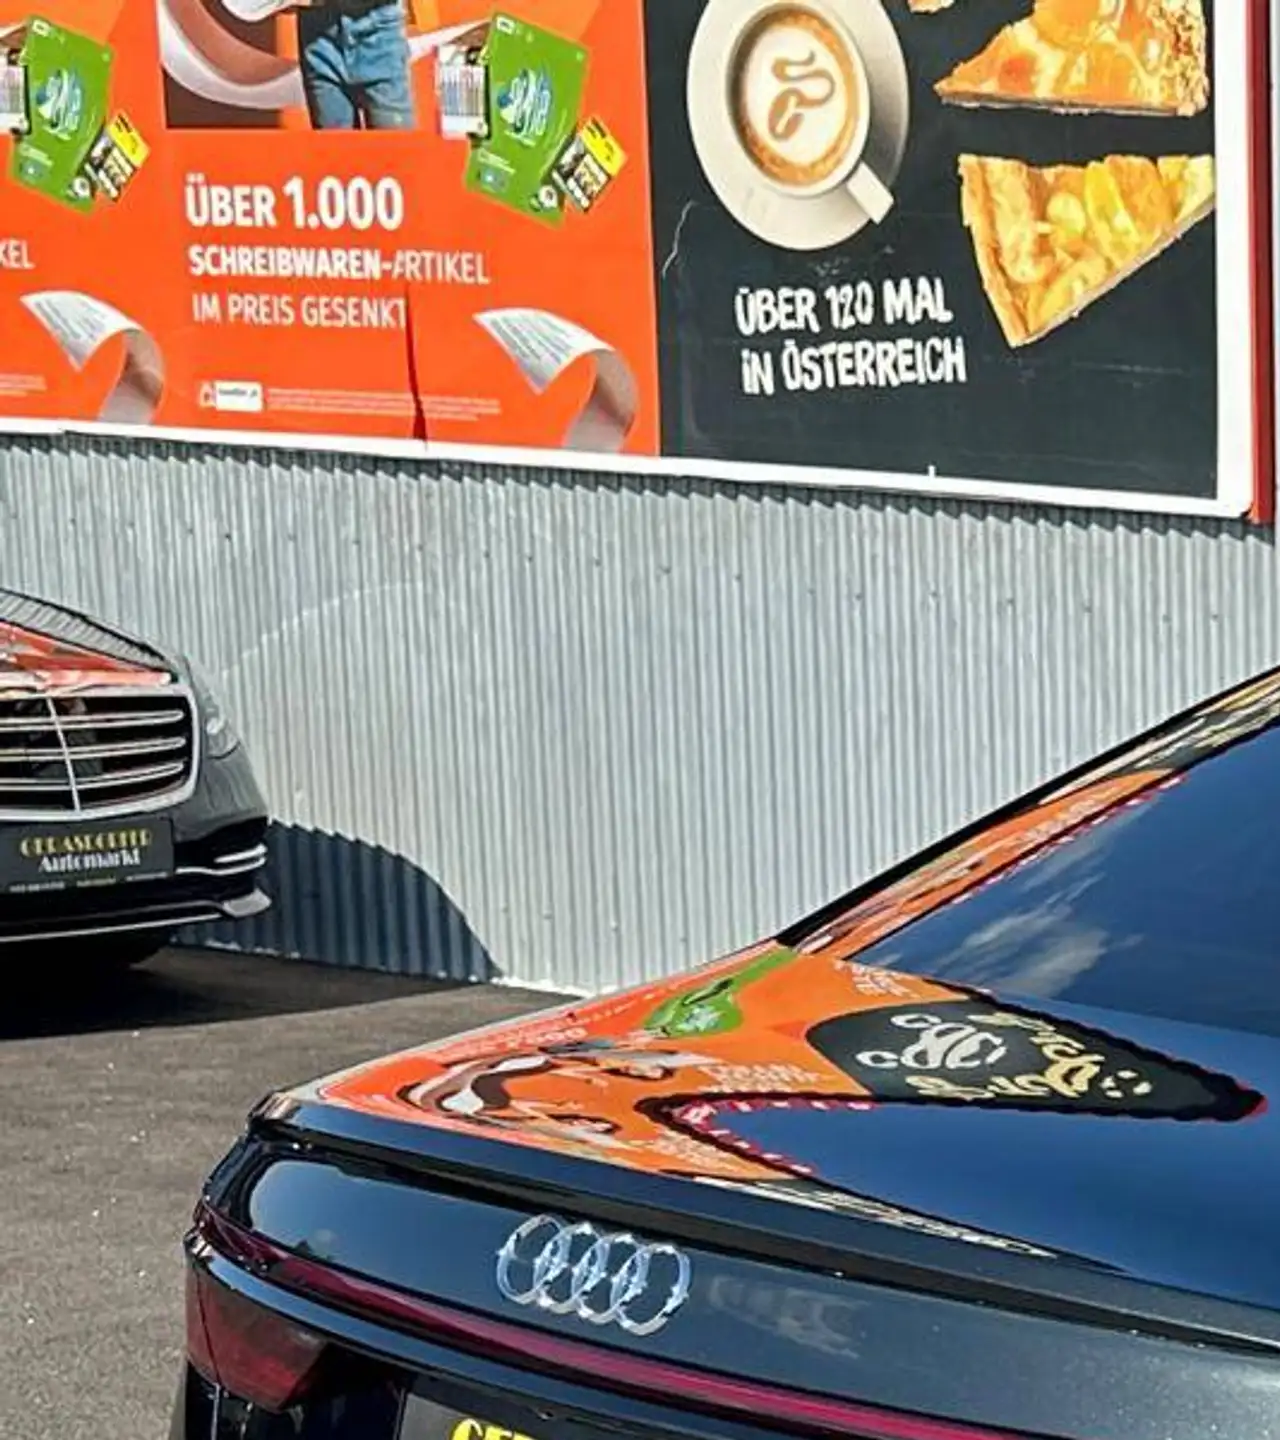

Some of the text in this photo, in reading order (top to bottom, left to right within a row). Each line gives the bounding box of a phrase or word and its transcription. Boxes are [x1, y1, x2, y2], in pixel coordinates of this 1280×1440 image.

[185, 172, 404, 230] ÜBER 1.000
[187, 244, 491, 285] SCHREIBWAREN-ARTIKEL
[192, 293, 408, 329] IM PREIS GESENKT
[734, 277, 954, 336] ÜBER 120 MAL
[781, 336, 967, 392] ÖSTERREICH
